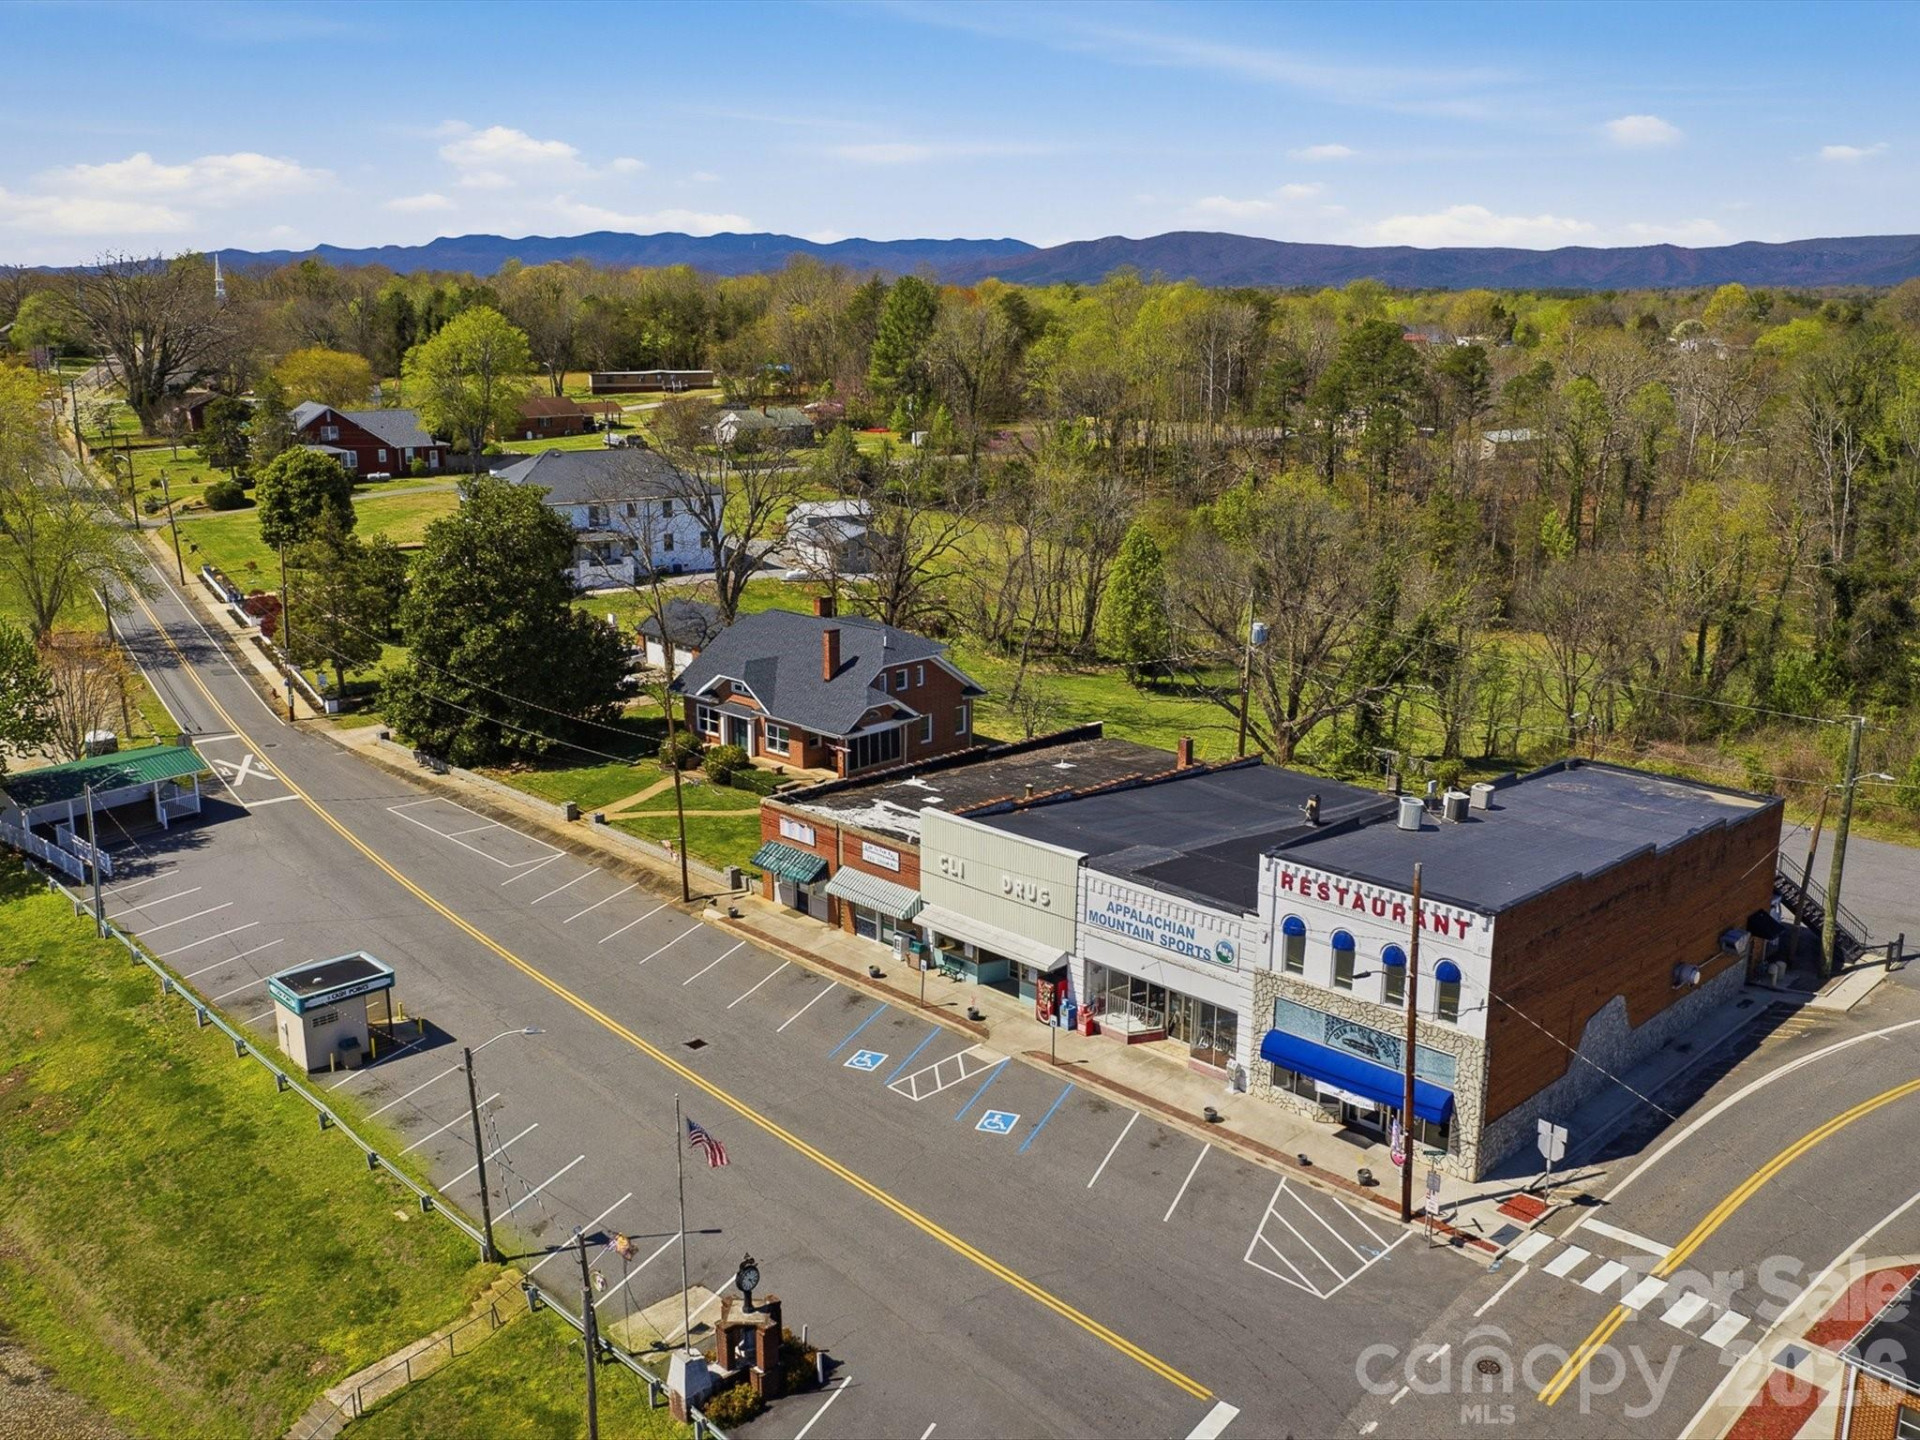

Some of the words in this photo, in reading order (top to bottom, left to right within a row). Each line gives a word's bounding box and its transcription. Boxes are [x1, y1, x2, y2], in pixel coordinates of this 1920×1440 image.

[1002, 875, 1051, 909] DRUG
[1280, 870, 1471, 940] RESTAURANT
[1088, 909, 1155, 942] MOUNTAIN
[1159, 933, 1212, 961] SPORTS
[1106, 900, 1196, 941] APPALACHIAN
[1333, 1027, 1348, 1040] GLEN
